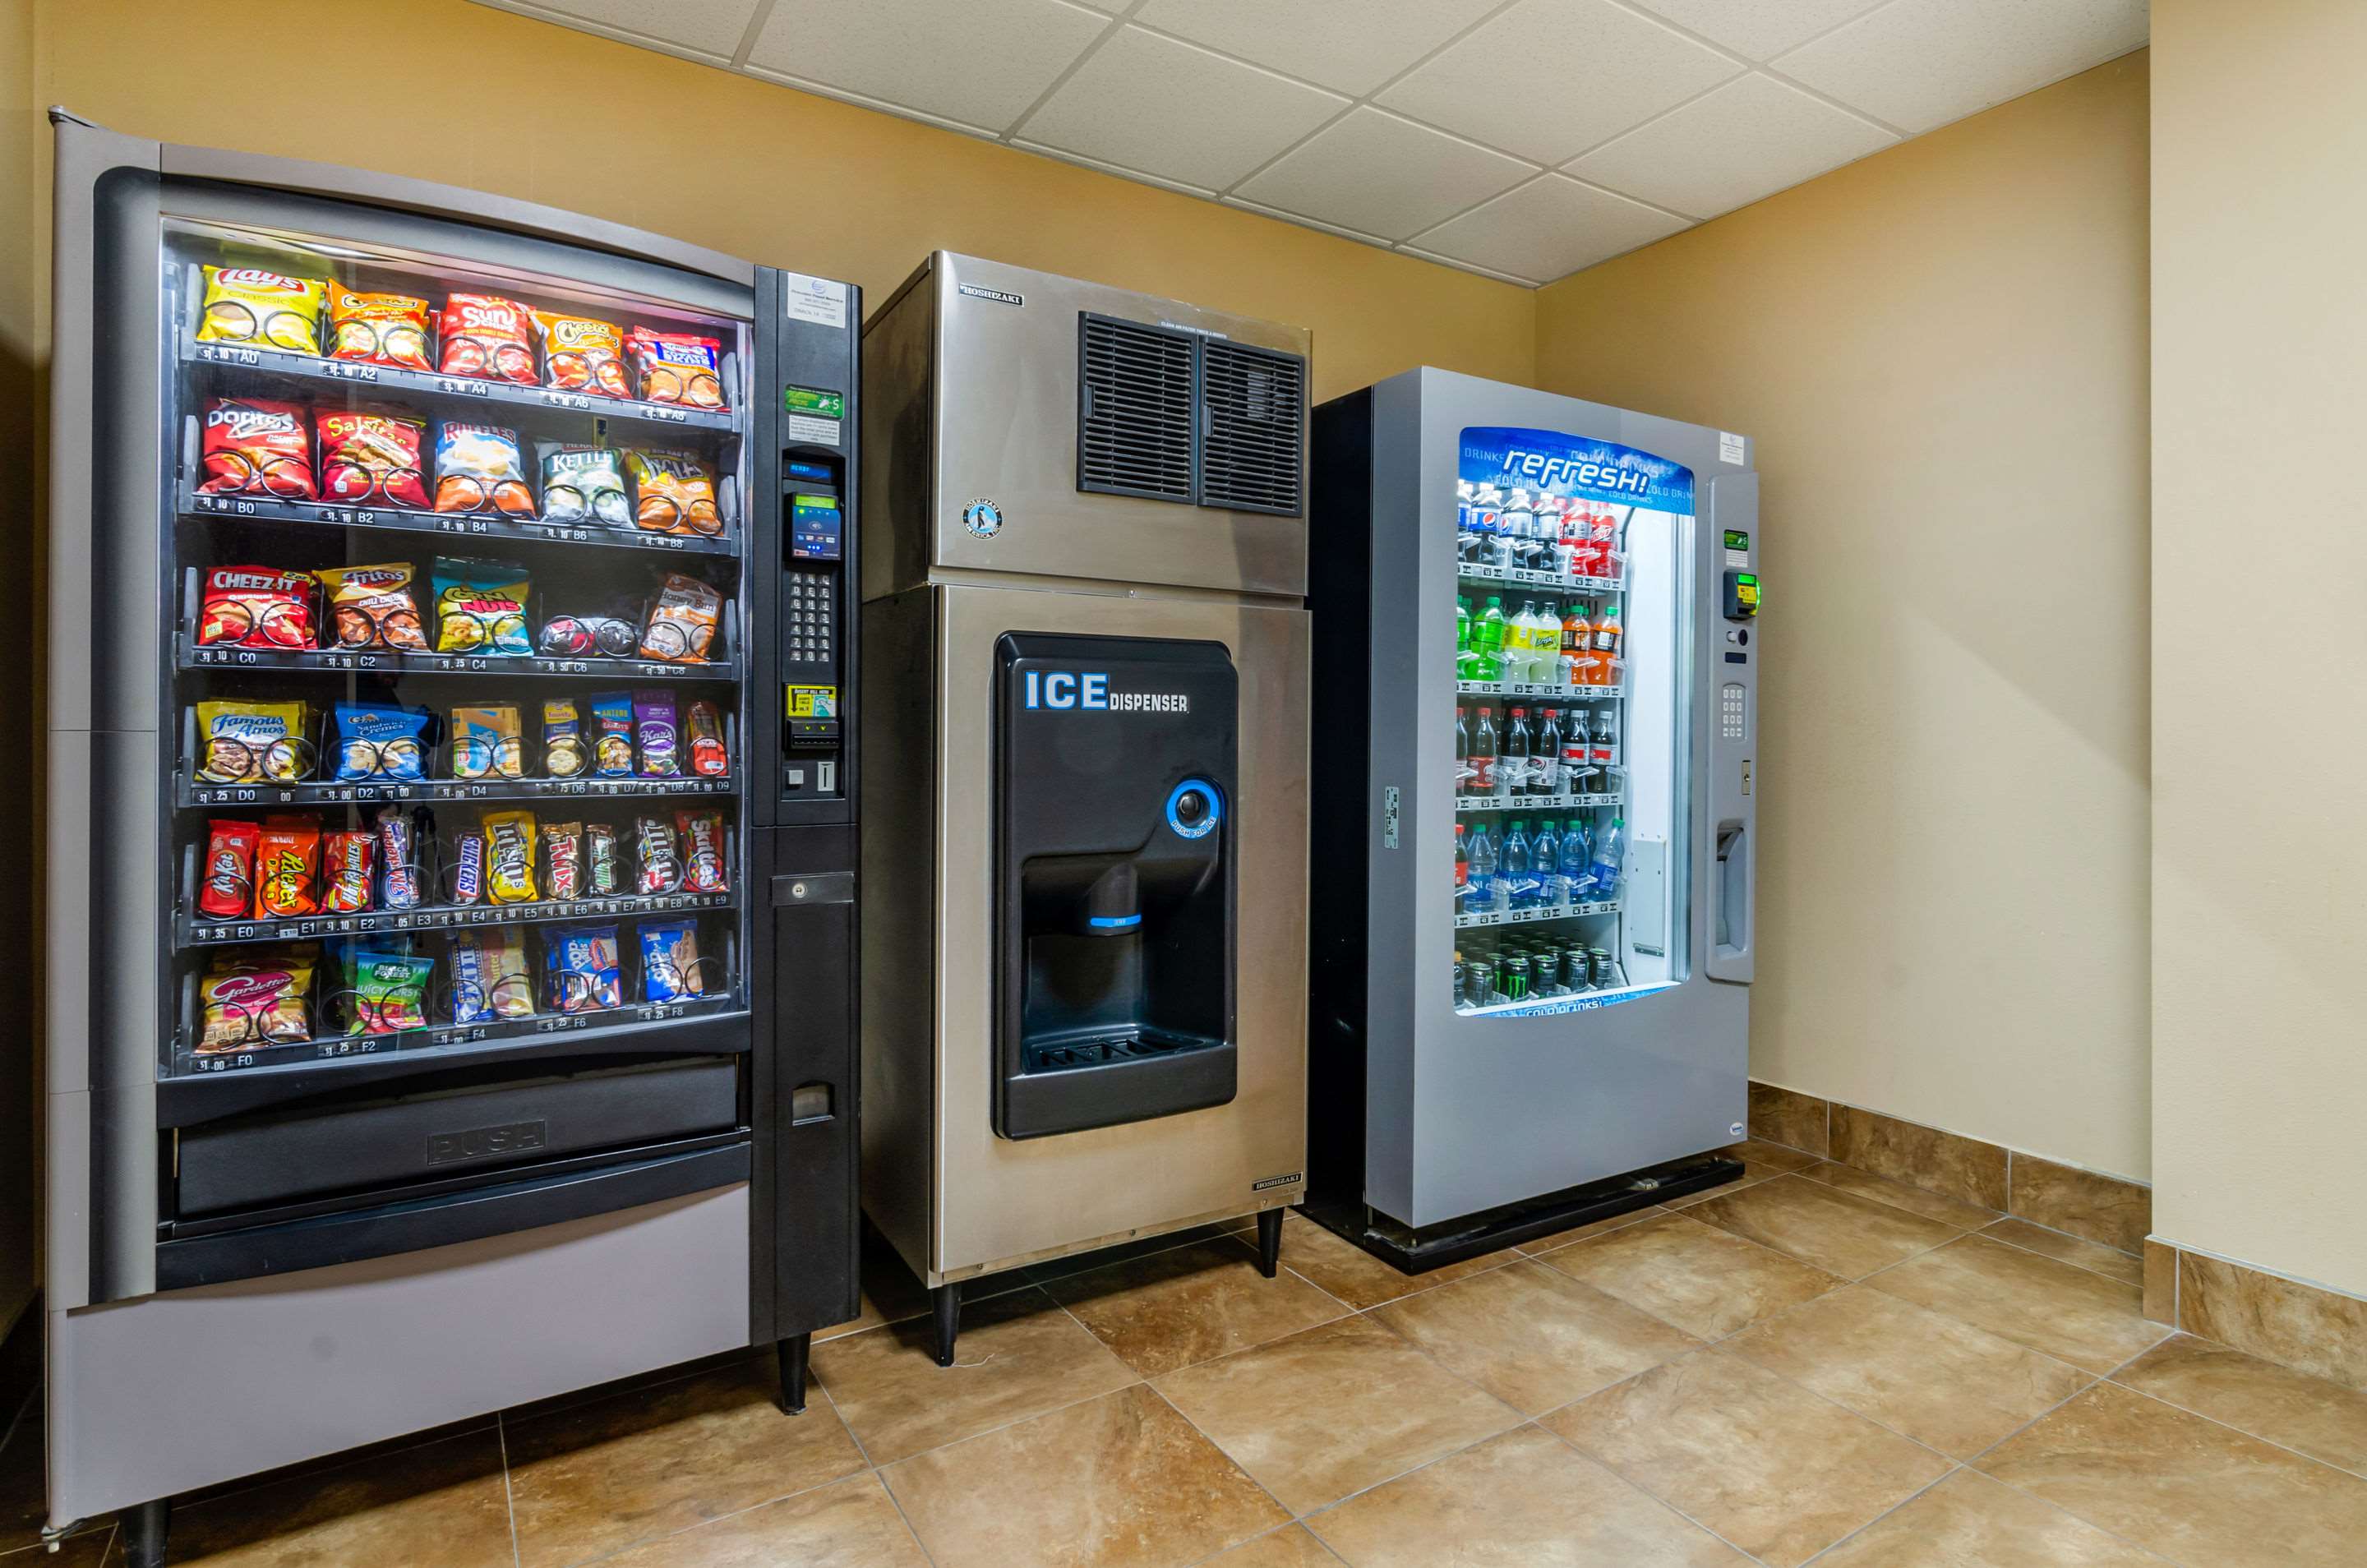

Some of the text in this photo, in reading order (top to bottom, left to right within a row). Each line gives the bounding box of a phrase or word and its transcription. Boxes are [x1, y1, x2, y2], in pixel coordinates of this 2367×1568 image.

[964, 285, 1022, 304] HOSHIZAKI
[462, 307, 514, 328] Sun
[240, 352, 258, 363] A0
[360, 370, 376, 380] A2
[471, 385, 487, 394] A4
[574, 398, 588, 408] A6
[238, 502, 255, 514] B0
[358, 513, 373, 523] B2
[473, 522, 487, 533] B4
[574, 530, 587, 541] B6
[460, 599, 521, 614] NUTS
[239, 653, 256, 663] C0
[360, 656, 376, 666] C2
[473, 660, 487, 670] C4
[574, 663, 588, 673] C6
[1026, 671, 1188, 713] ICE DISPENSER
[473, 786, 487, 796] D4
[572, 784, 586, 794] D6
[624, 782, 637, 793] D7
[671, 782, 685, 791] D8
[717, 780, 730, 791] D9
[238, 790, 256, 801] D0
[358, 787, 374, 799] D2
[1171, 816, 1216, 836] PUSH FOR ICE
[459, 837, 481, 894] SNICKERS
[549, 835, 574, 892] TWIX
[671, 898, 682, 908] E8
[716, 895, 727, 905] E9
[575, 904, 588, 915] E6
[624, 901, 635, 912] E7
[473, 911, 486, 922] E4
[524, 907, 538, 919] E5
[361, 918, 376, 929] E2
[418, 915, 431, 925] E3
[238, 926, 254, 938] E0
[302, 922, 316, 933] E1
[671, 1007, 683, 1017] F8
[574, 1017, 586, 1027] F6
[473, 1028, 486, 1039] F4
[362, 1041, 376, 1052] F2
[238, 1055, 253, 1066] F0
[438, 1131, 540, 1155] PUSH
[1256, 1174, 1300, 1191] HOSHIZAKI
